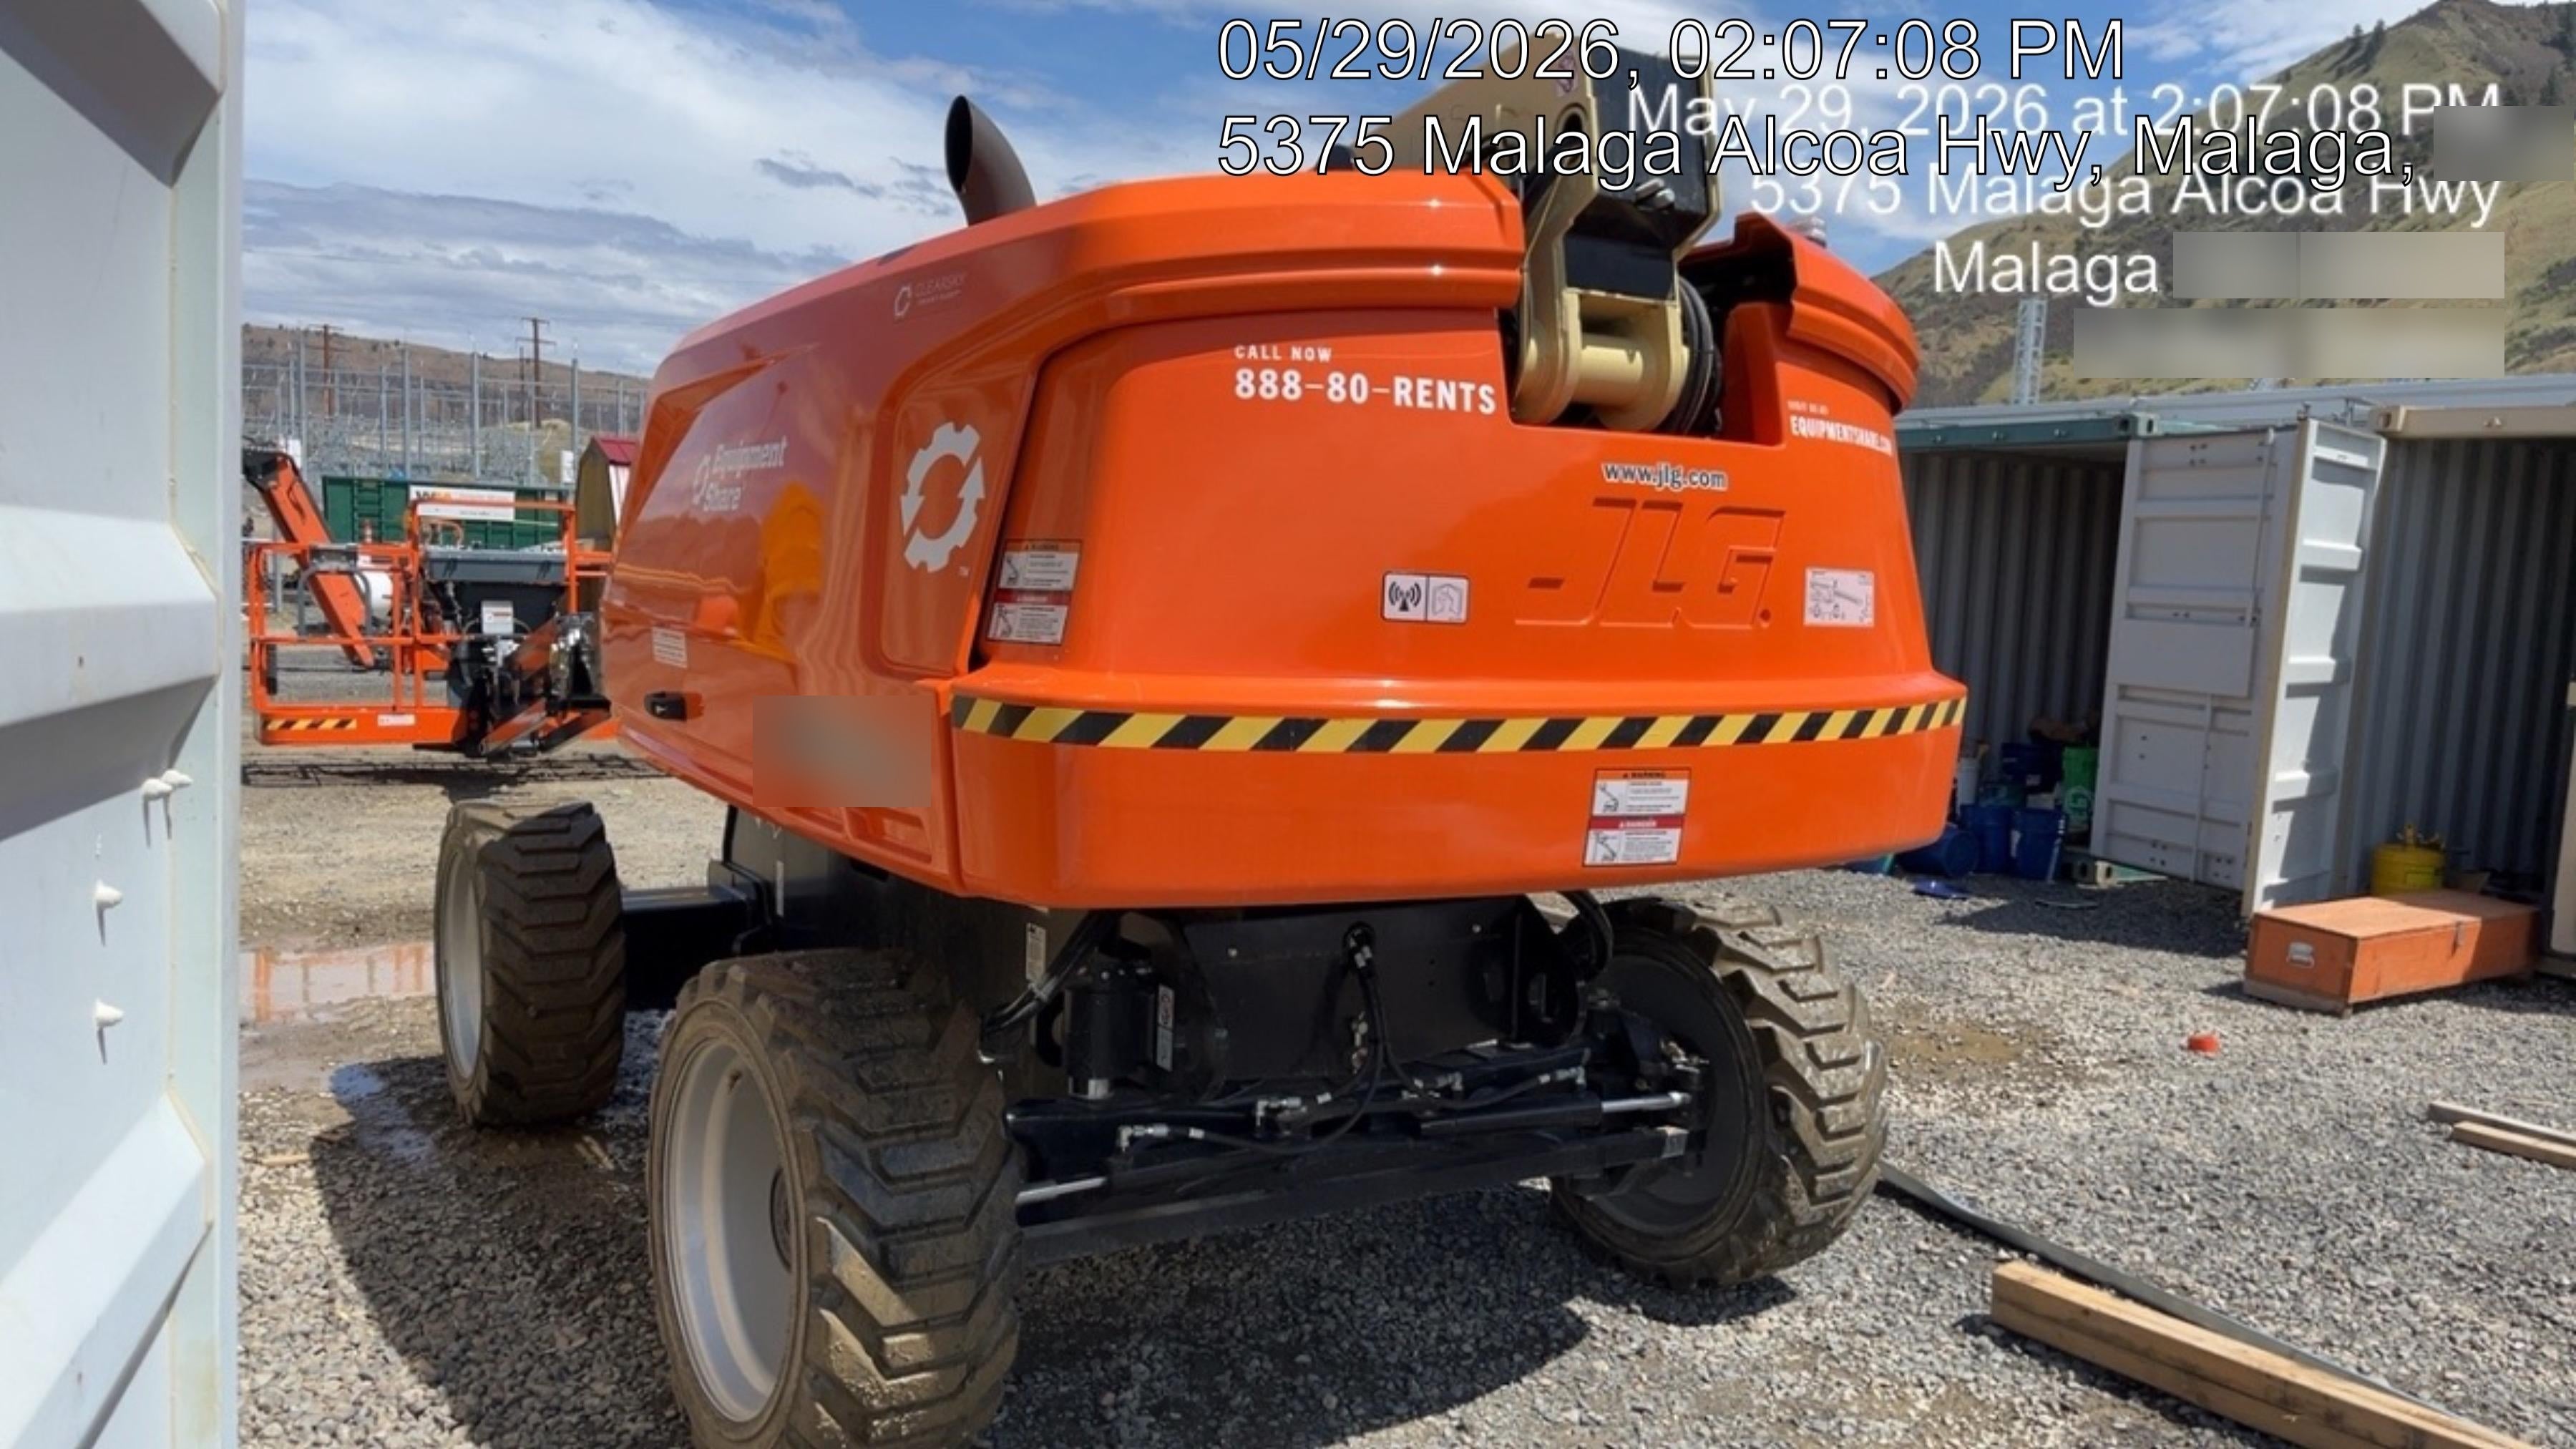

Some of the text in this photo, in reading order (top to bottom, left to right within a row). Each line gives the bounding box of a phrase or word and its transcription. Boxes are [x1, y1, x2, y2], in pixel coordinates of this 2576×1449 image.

[1234, 345, 1332, 362] CALL NOW
[1235, 368, 1497, 416] 888-80-RENTS
[1602, 462, 1727, 491] www.jlg.com
